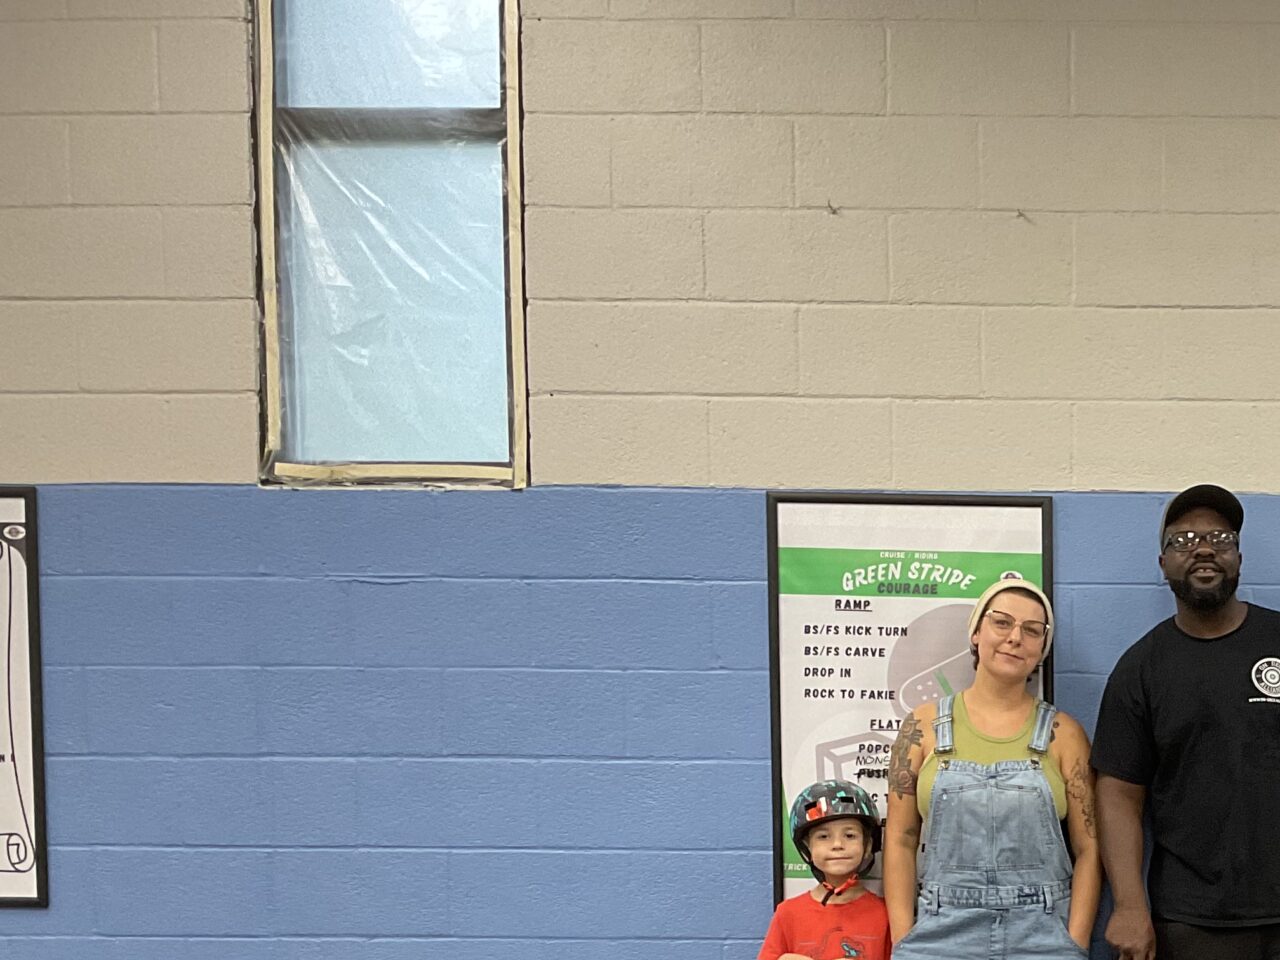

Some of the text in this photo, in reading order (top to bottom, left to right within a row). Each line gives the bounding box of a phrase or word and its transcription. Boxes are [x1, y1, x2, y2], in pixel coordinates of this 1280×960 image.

[842, 561, 976, 591] GREEN STRIPE
[877, 583, 938, 595] COURAGE
[835, 599, 871, 610] RAMP
[804, 625, 908, 637] BS/FS KICK TURN
[804, 646, 886, 658] BS/FS CARVE
[804, 667, 852, 679] DROP IN
[804, 688, 896, 701] ROCK TO FAKIE
